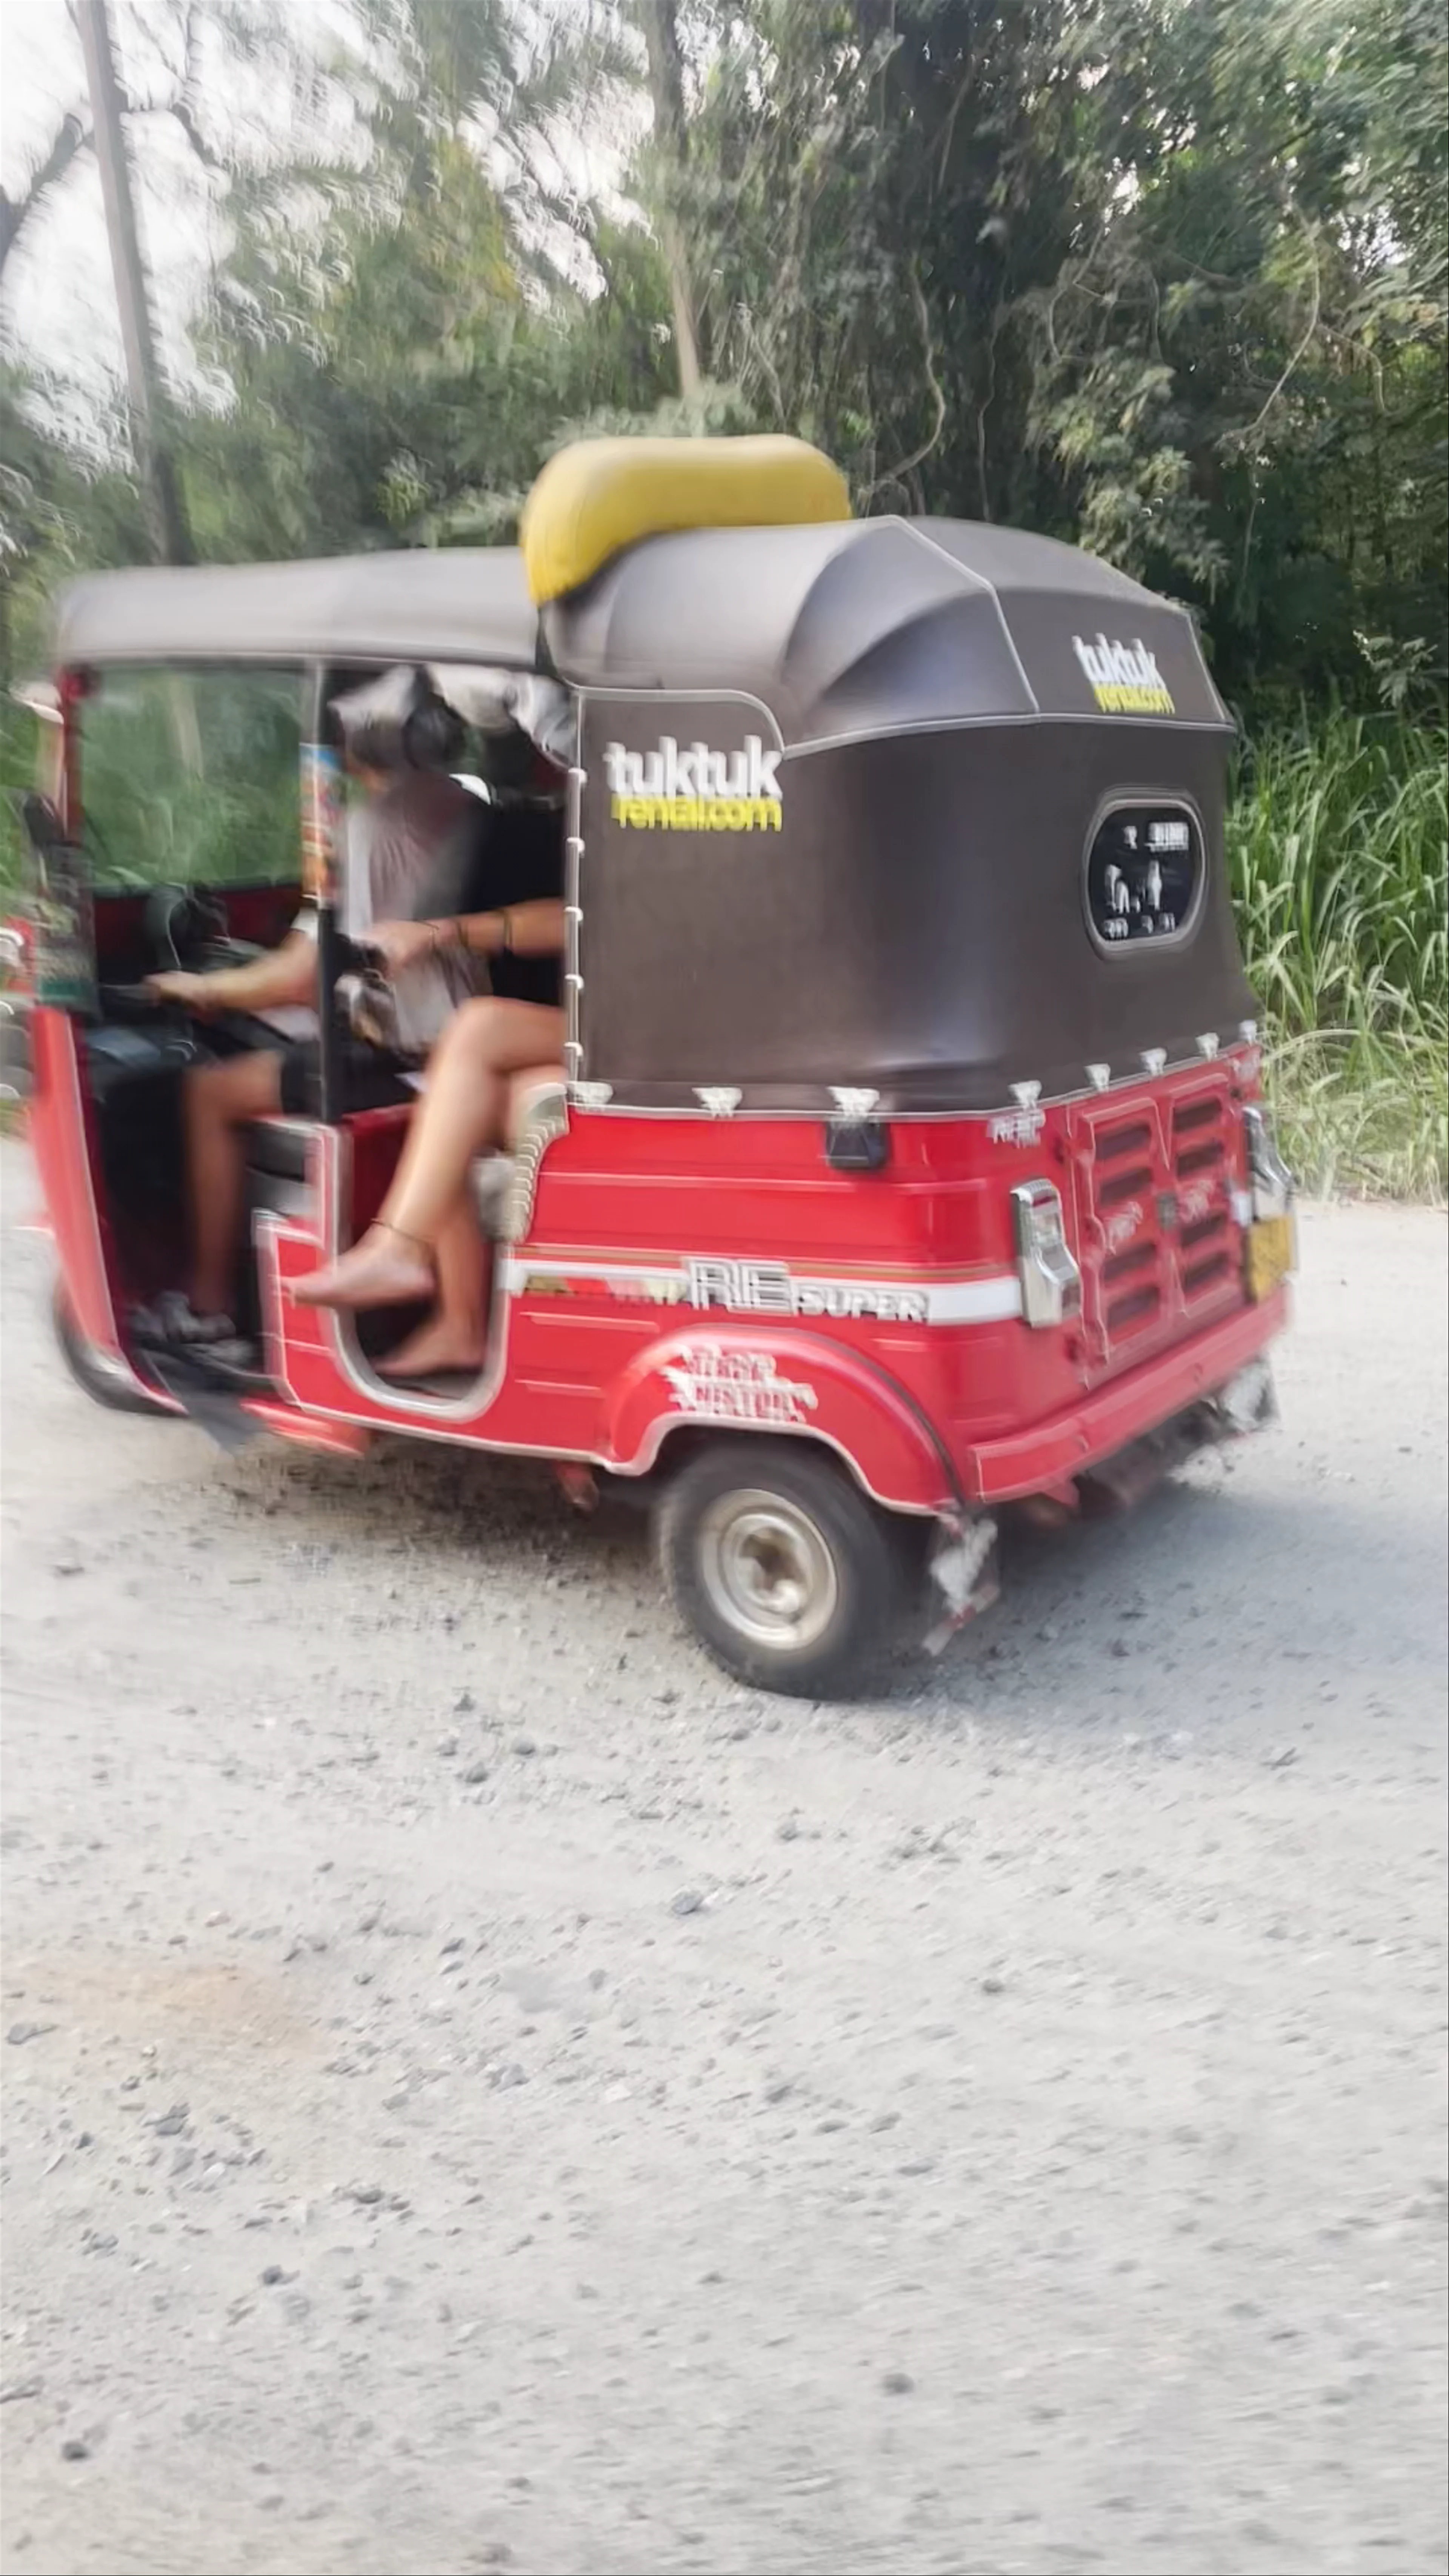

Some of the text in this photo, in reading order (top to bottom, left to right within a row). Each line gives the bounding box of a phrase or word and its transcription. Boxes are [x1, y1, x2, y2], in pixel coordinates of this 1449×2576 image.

[1072, 632, 1168, 691] tuktuk
[603, 735, 783, 800] tuktuk
[611, 792, 782, 831] rental.com
[683, 1256, 792, 1315] RE
[797, 1284, 928, 1323] SUPER
